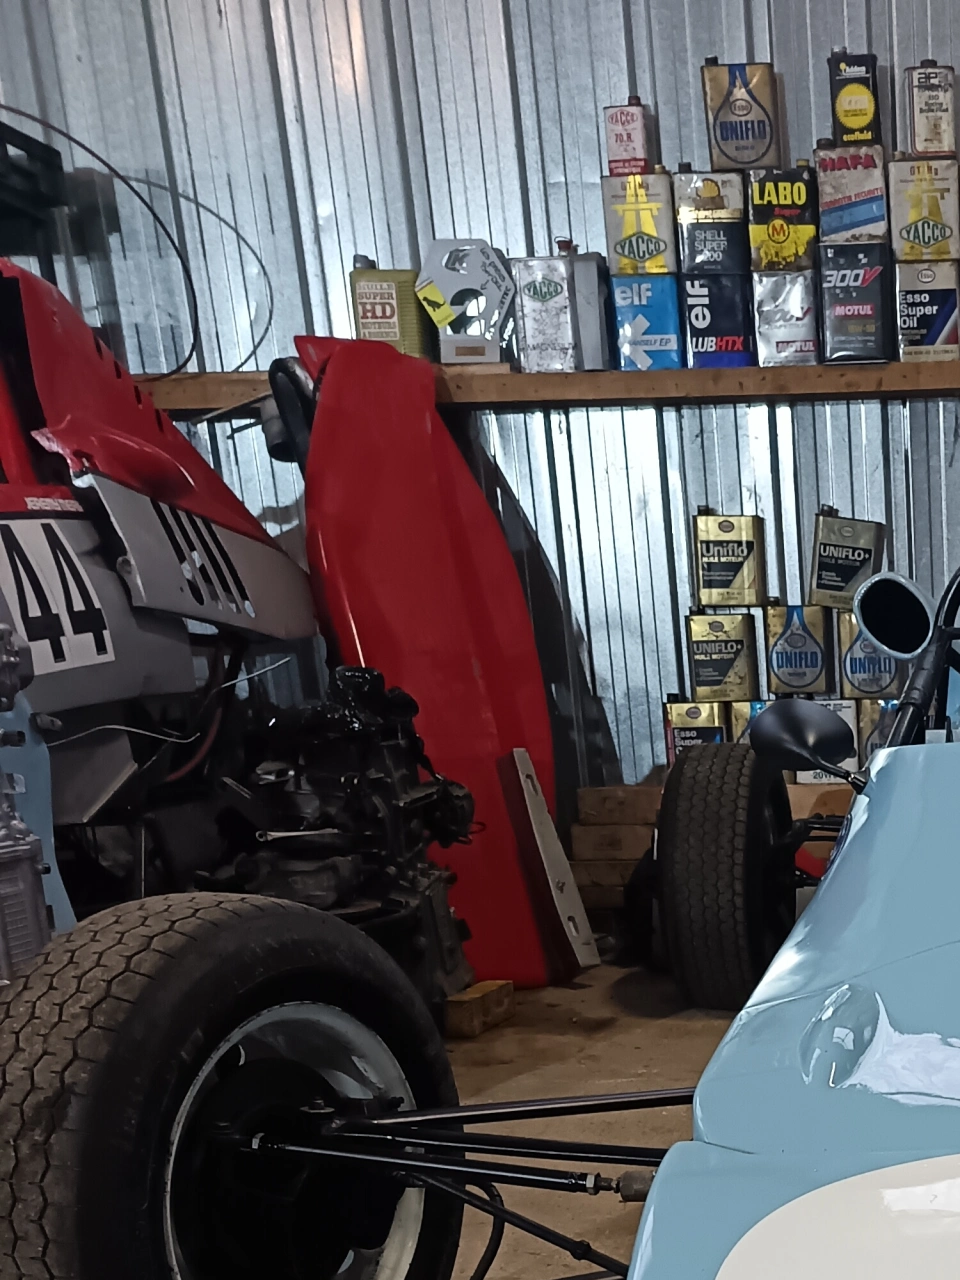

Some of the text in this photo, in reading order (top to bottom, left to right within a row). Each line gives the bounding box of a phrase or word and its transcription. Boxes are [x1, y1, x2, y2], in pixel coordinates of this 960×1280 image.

[610, 111, 635, 126] YACCO
[719, 119, 767, 141] UNIFLO
[752, 181, 807, 206] LABO
[773, 207, 801, 217] Super
[694, 229, 727, 241] SHELL
[771, 223, 786, 238] M
[905, 220, 946, 245] YACCO
[620, 235, 660, 260] YACCO
[694, 240, 728, 251] SUPER
[822, 265, 884, 288] 300V
[920, 271, 933, 280] Esso
[358, 292, 395, 301] SUPER
[526, 279, 559, 299] YACCO
[614, 283, 653, 307] elf
[685, 280, 712, 329] elf
[899, 291, 930, 304] Esso
[358, 301, 396, 320] HD
[835, 305, 873, 316] MOTUL
[900, 304, 938, 317] Super
[900, 316, 918, 328] Oil
[659, 337, 672, 347] EP
[777, 341, 815, 353] MOTUL
[701, 542, 748, 557] Uniflo
[0, 522, 109, 664] 44
[775, 651, 819, 669] UNIFLO
[674, 728, 697, 738] Esso
